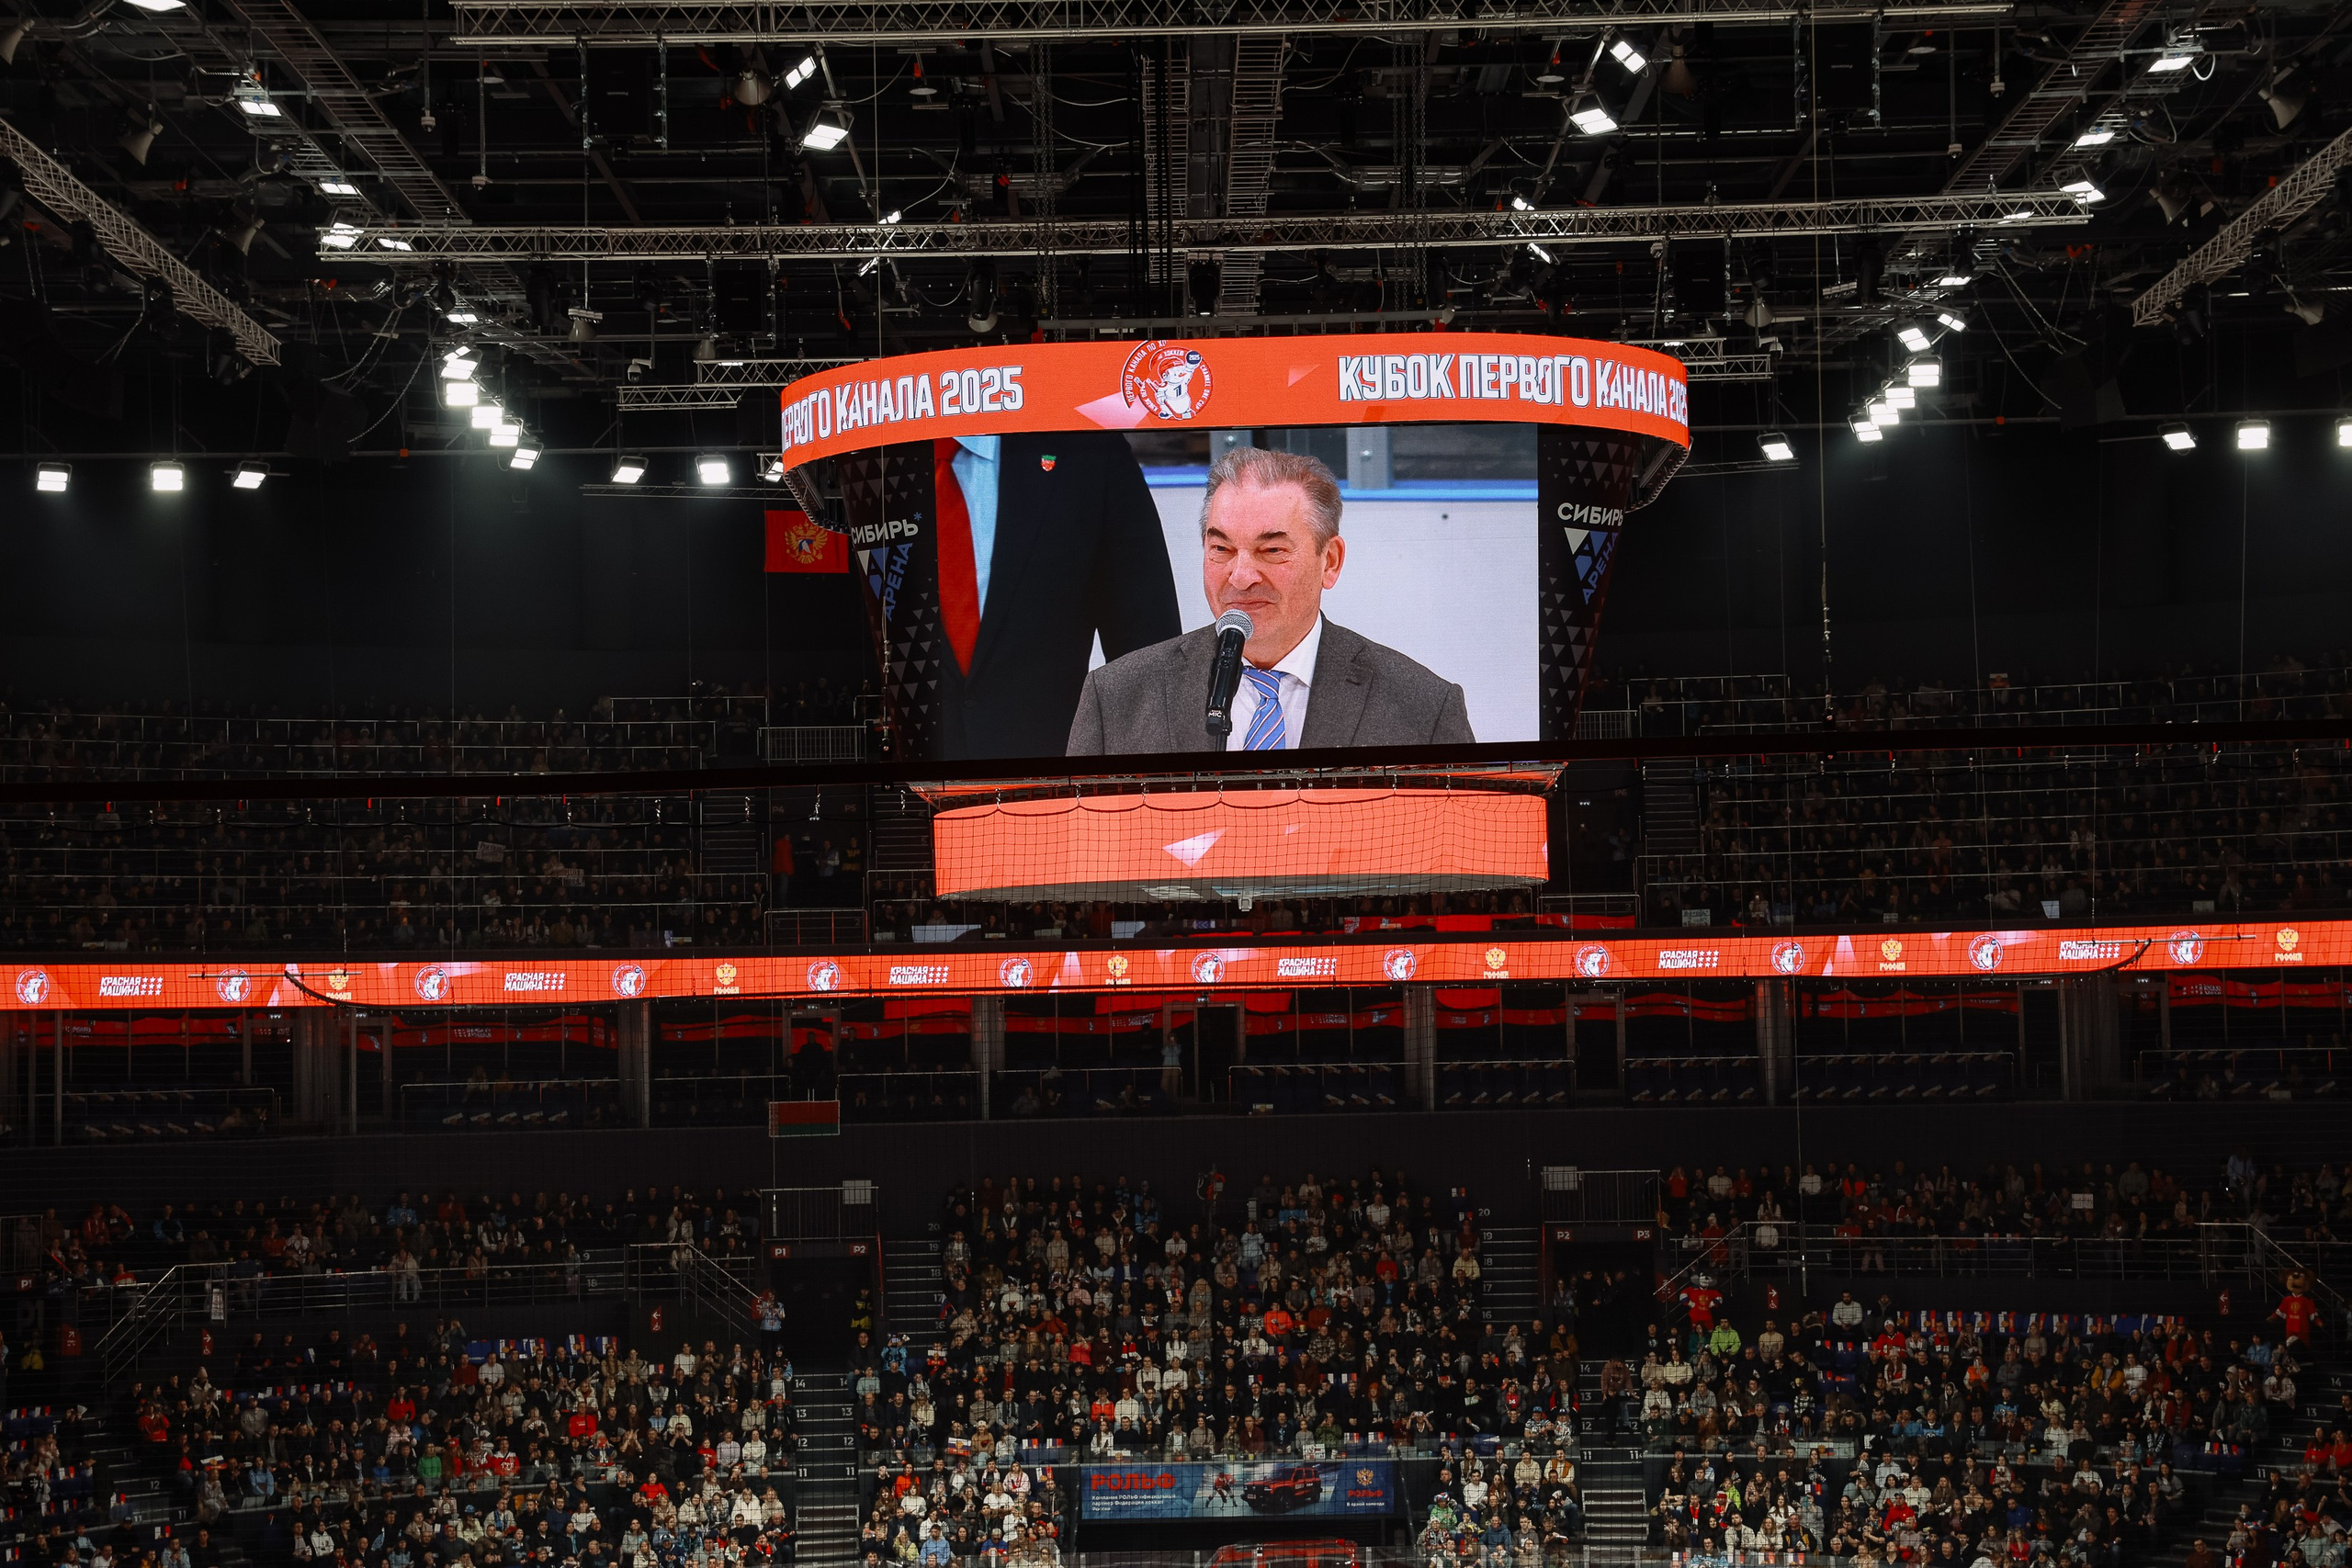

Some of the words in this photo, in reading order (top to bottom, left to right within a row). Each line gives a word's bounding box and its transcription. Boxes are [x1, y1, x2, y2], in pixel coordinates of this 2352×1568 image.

[1338, 354, 1455, 402] КУБОК
[1458, 354, 1591, 408] ПЕРВОГО
[1594, 358, 1668, 418] КАНАЛА
[834, 373, 935, 435] КАНАЛА
[939, 366, 1024, 417] 2025
[1557, 502, 1623, 526] СИБИРЬ
[851, 519, 919, 545] СИБИРЬ
[1582, 532, 1618, 605] АРЕНА
[885, 542, 913, 623] АРЕНА
[1658, 951, 1698, 959] КРАСНАЯ
[2059, 950, 2099, 960] МАШИНА
[1277, 958, 1316, 966] КРАСНАЯ
[1658, 959, 1698, 968] МАШИНА
[889, 966, 929, 975] КРАСНАЯ
[1276, 966, 1316, 976] МАШИНА
[100, 976, 141, 986] КРАСНАЯ
[504, 973, 544, 982] КРАСНАЯ
[888, 975, 929, 984] МАШИНА
[99, 986, 140, 996] МАШИНА
[503, 982, 544, 991] МАШИНА
[1477, 1208, 1490, 1217] 20
[928, 1223, 940, 1232] 20
[1482, 1232, 1493, 1241] 19
[1556, 1231, 1570, 1240] P2
[1636, 1230, 1650, 1239] P3
[775, 1247, 786, 1257] P1
[854, 1246, 866, 1254] P2
[929, 1243, 939, 1252] 19
[20, 1280, 32, 1290] P1
[1482, 1311, 1492, 1320] 16
[1580, 1364, 1591, 1373] 14
[795, 1379, 806, 1388] 14
[2331, 1378, 2342, 1388] 14
[1580, 1392, 1592, 1401] 13
[796, 1409, 807, 1418] 13
[842, 1407, 853, 1416] 13
[2306, 1407, 2317, 1417] 13
[1581, 1421, 1592, 1431] 12
[843, 1437, 854, 1446] 12
[2282, 1437, 2293, 1447] 12
[1582, 1450, 1592, 1461] 11
[1629, 1450, 1639, 1460] 11
[798, 1468, 808, 1477] 11
[845, 1466, 855, 1476] 11
[2256, 1468, 2267, 1478] 11
[150, 1480, 160, 1490] 12
[1091, 1472, 1175, 1491] РОЛЬФ
[1347, 1489, 1384, 1497] РОЛЬФ
[177, 1509, 187, 1519] 11
